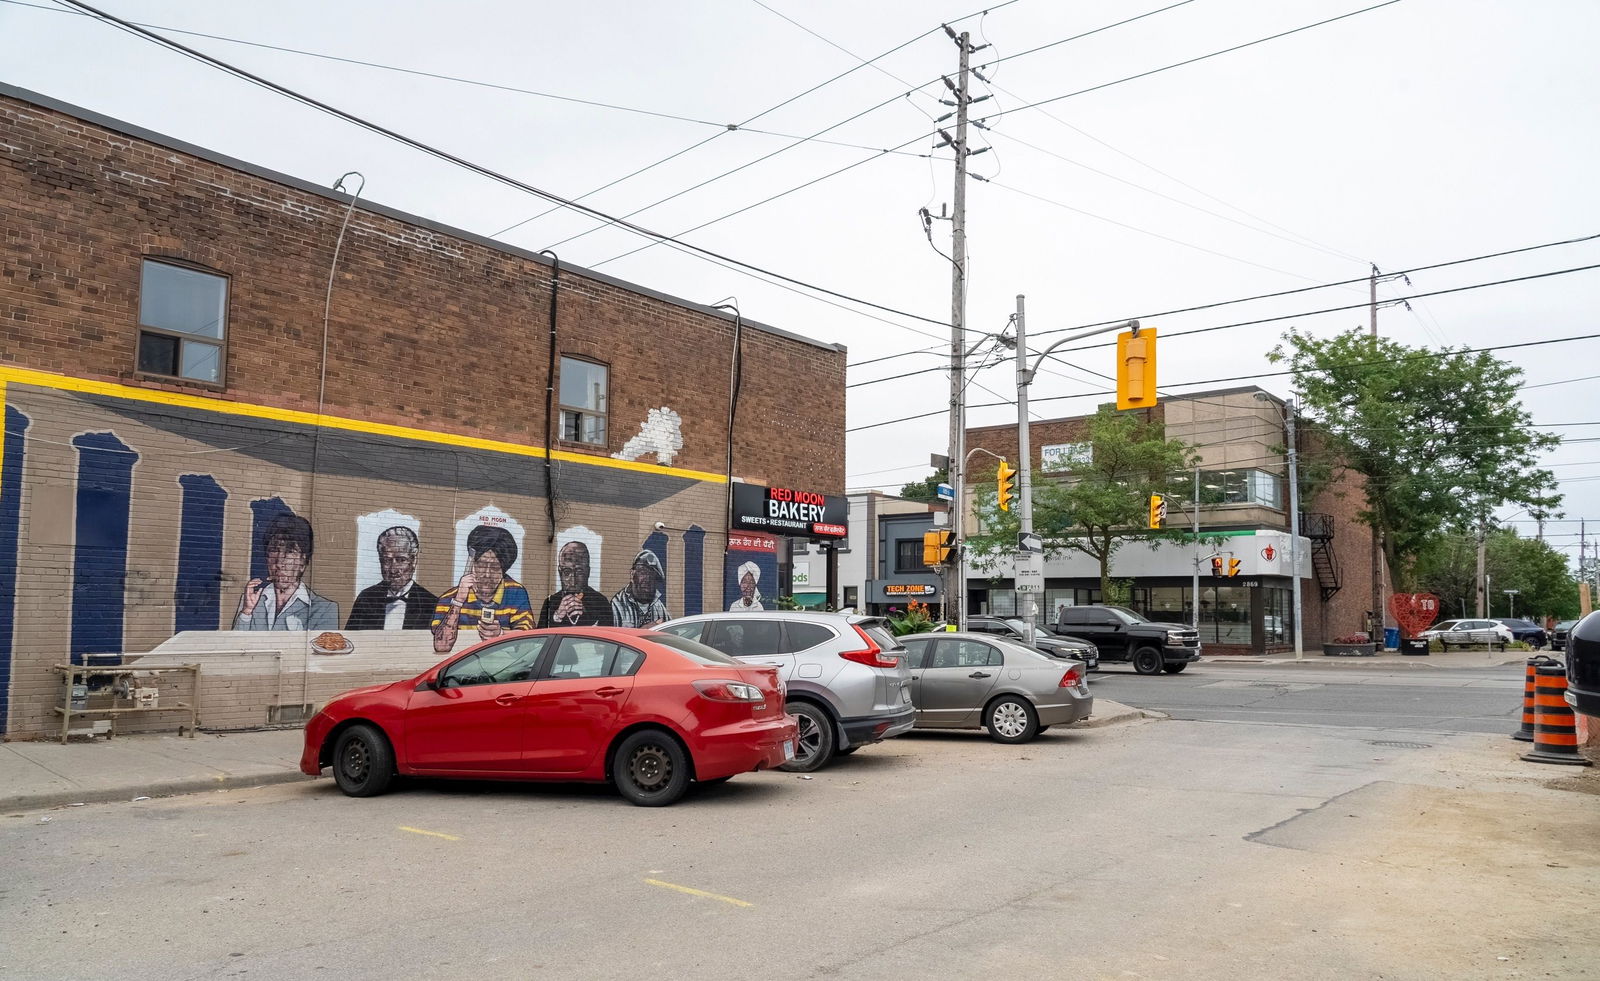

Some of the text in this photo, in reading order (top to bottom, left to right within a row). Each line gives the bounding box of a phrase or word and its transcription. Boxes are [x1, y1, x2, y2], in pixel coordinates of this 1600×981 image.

[1044, 447, 1061, 457] FOR
[770, 487, 825, 506] RED MOON
[769, 499, 826, 523] BAKERY
[741, 515, 767, 525] SWEETS
[770, 519, 807, 529] RESTAURANT
[906, 584, 925, 592] ZONE
[1420, 599, 1435, 610] TO
